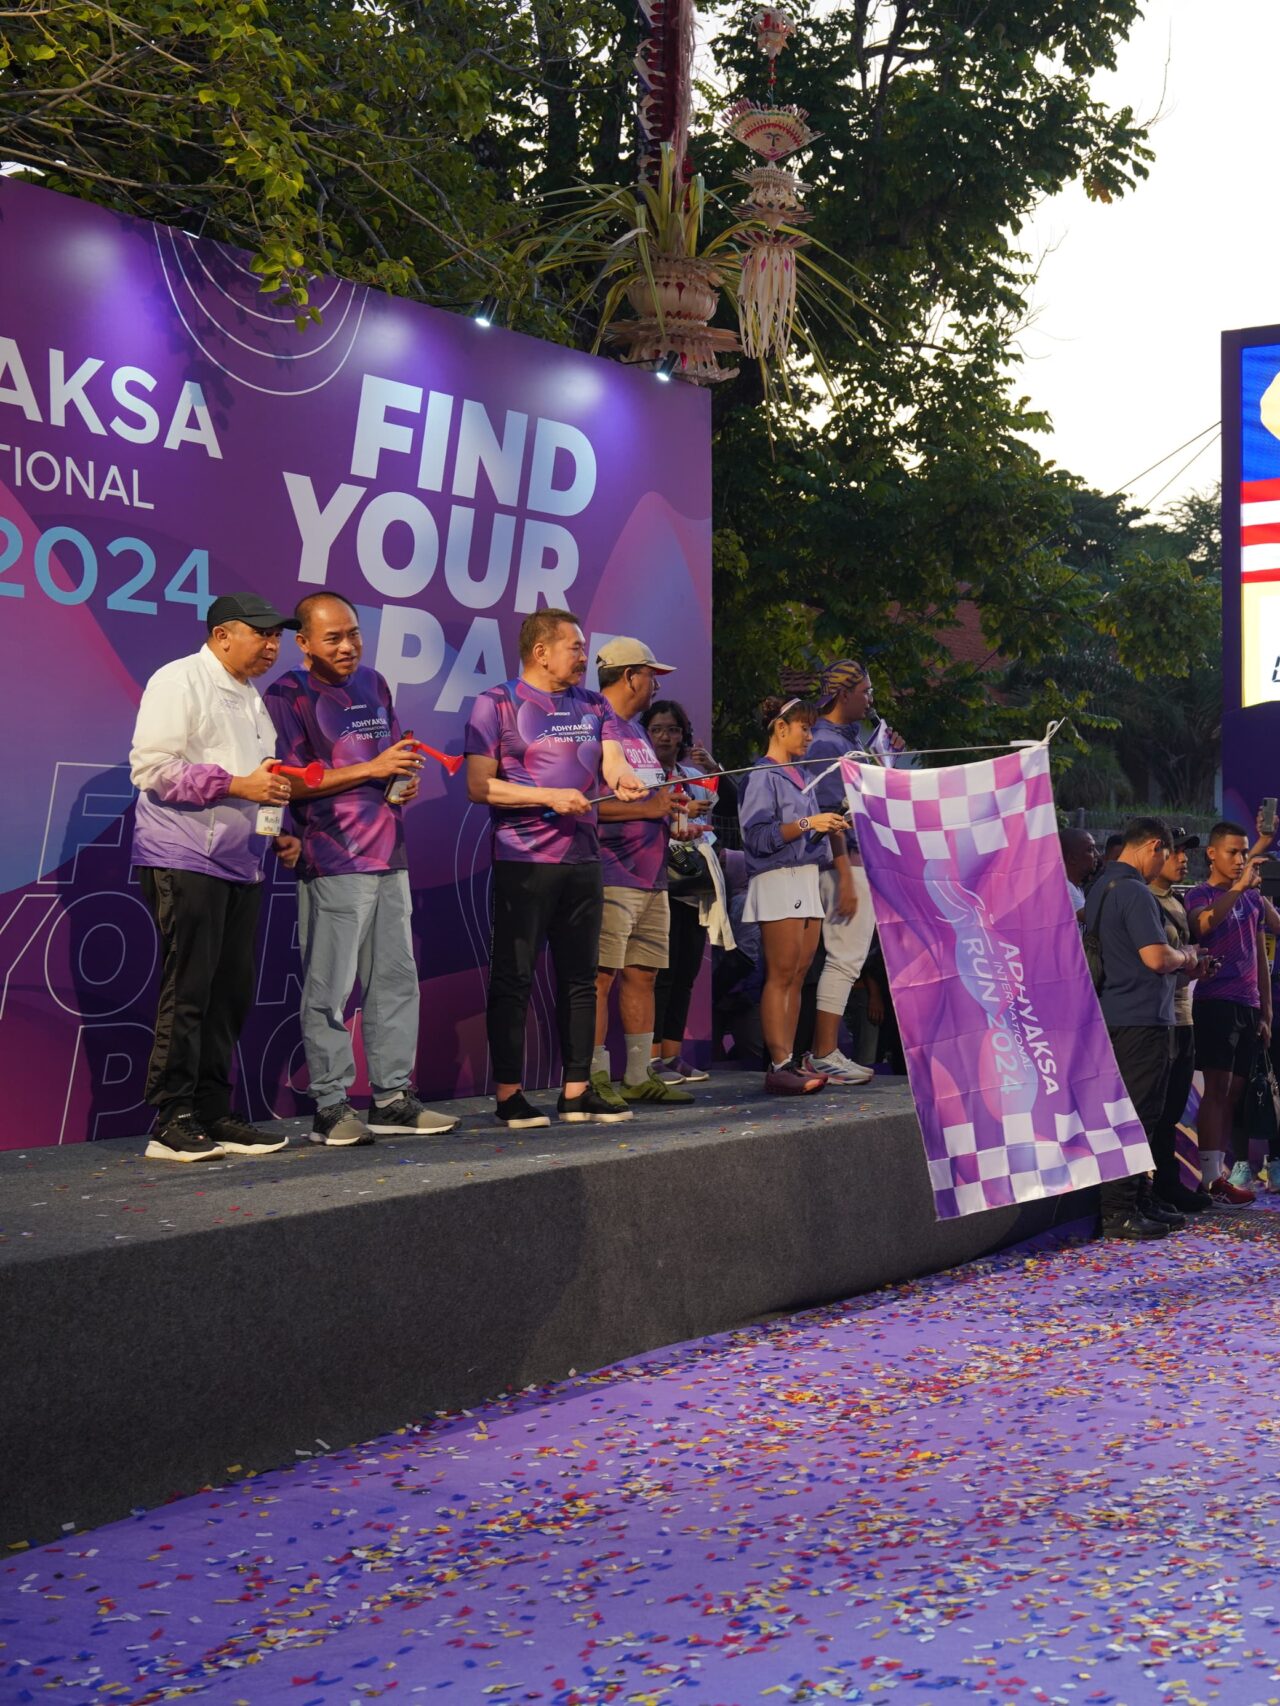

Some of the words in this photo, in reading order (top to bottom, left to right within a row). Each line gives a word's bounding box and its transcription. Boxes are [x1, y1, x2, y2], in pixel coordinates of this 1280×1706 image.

[350, 374, 597, 517] FIND
[0, 517, 218, 621] 2024
[282, 471, 580, 614] YOUR
[355, 732, 373, 741] RUN
[551, 723, 594, 732] ADHYAKSA
[574, 735, 597, 743] 2024
[961, 937, 1000, 1002] RUN
[986, 1012, 1023, 1095] 2024
[993, 961, 1033, 1071] INTERNATIONAL
[998, 940, 1059, 1096] ADHYAKSA
